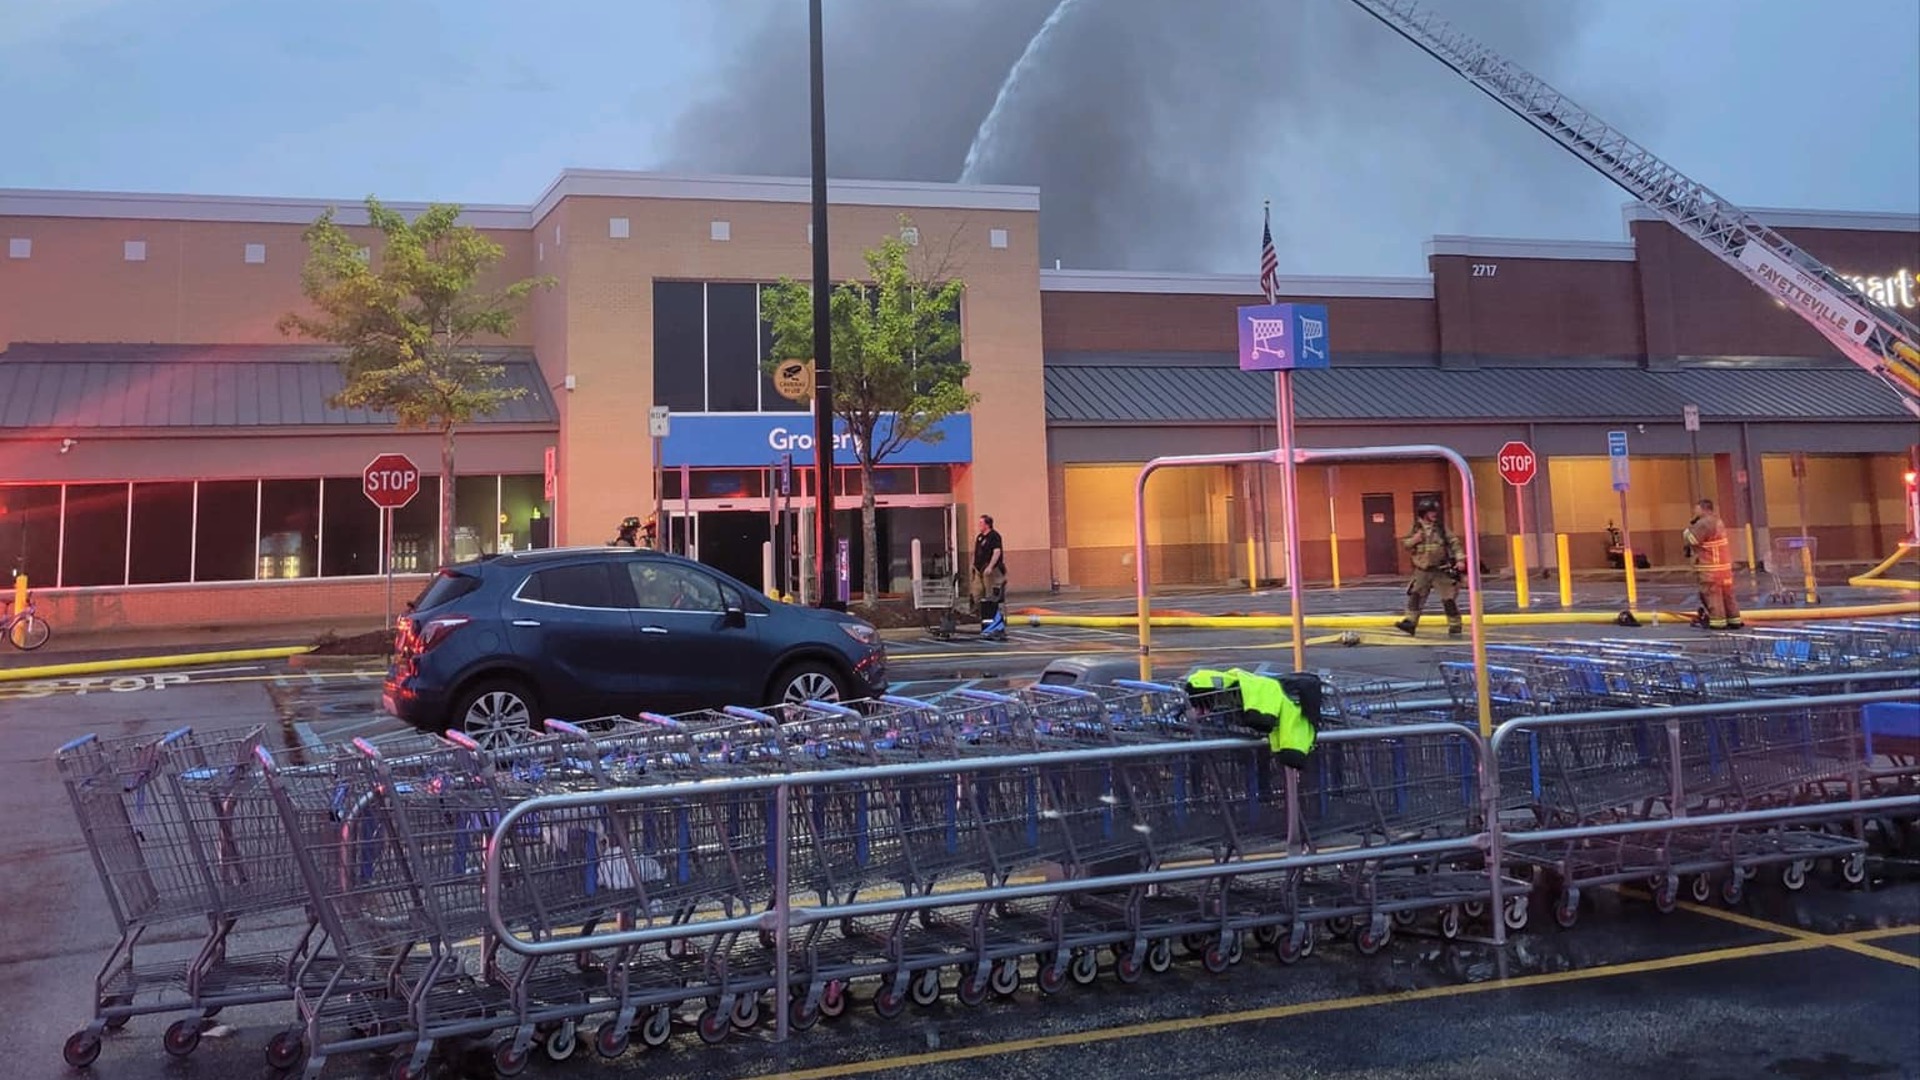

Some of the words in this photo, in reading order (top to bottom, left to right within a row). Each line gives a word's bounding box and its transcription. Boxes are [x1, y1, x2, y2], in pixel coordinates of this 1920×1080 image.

[1472, 264, 1498, 276] 2717
[1757, 262, 1849, 331] FAYETTEVILLE
[1501, 455, 1532, 472] STOP
[368, 470, 416, 491] STOP
